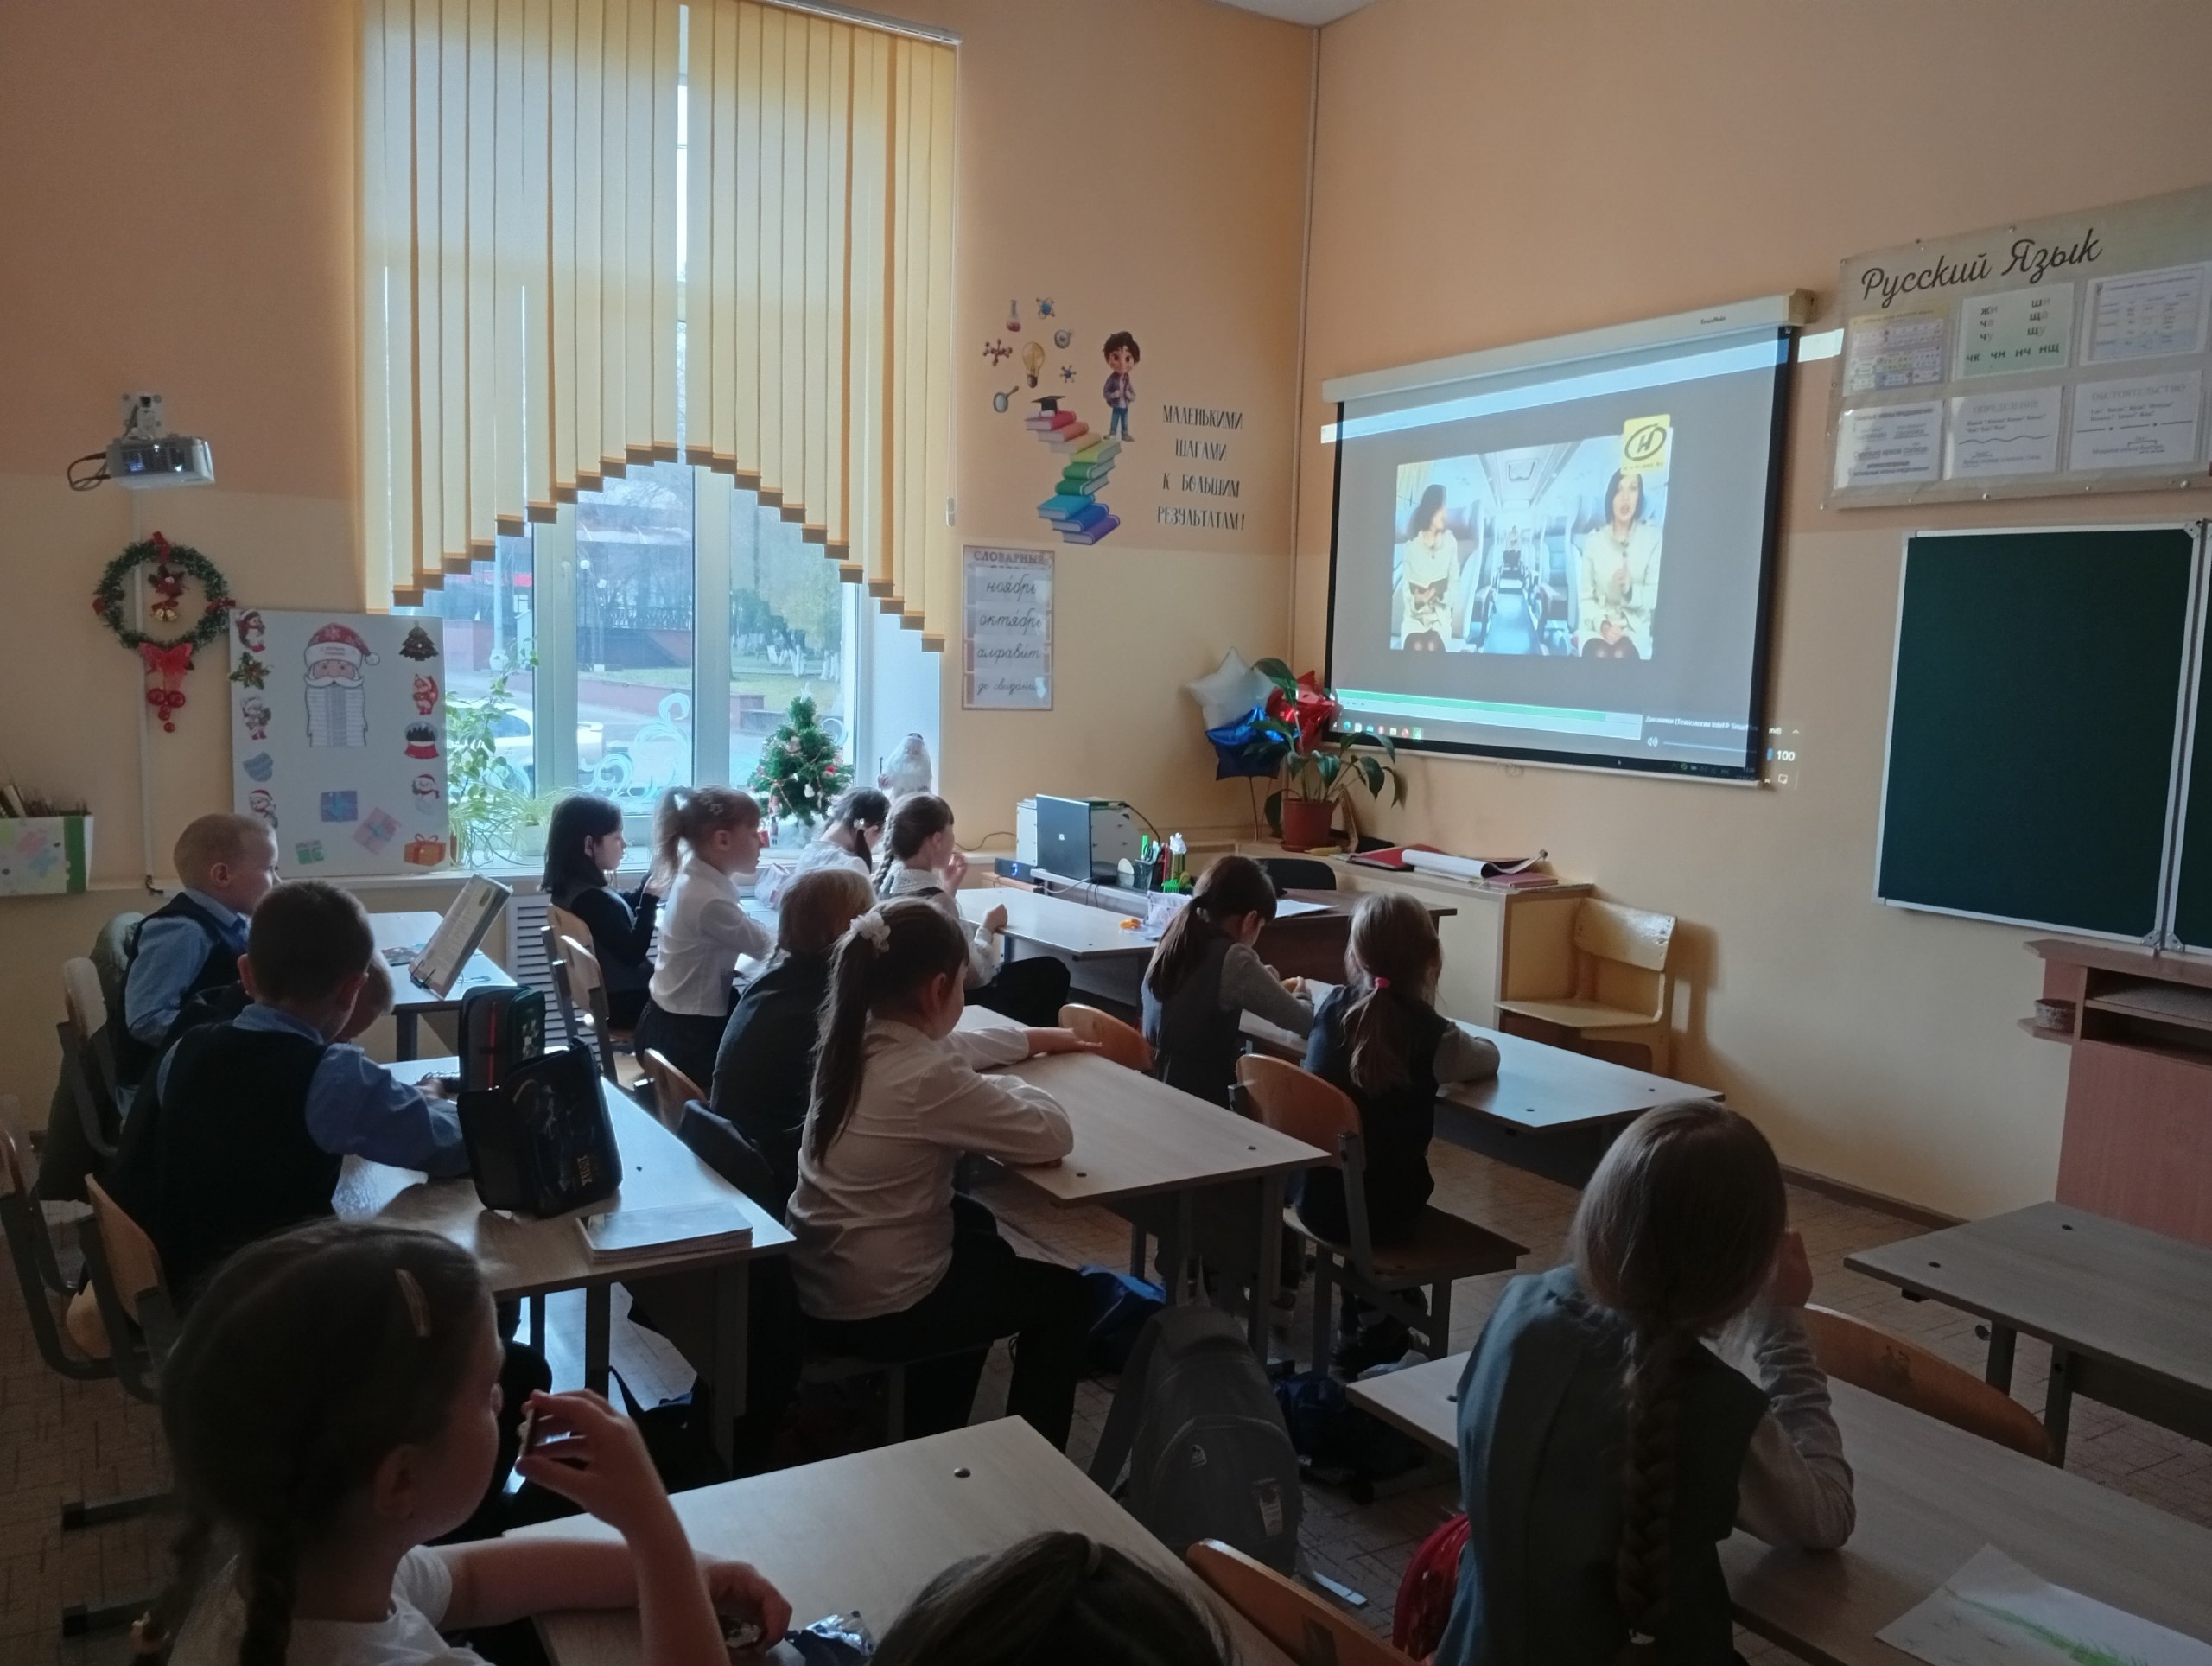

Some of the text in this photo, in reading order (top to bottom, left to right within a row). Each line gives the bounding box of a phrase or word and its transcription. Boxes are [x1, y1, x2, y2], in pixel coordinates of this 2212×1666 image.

[1861, 228, 2103, 308] Русский Язык
[1163, 405, 1243, 430] МАЛЕНЬКИМИ
[1176, 438, 1227, 461] ШАГАМИ
[1163, 473, 1240, 499] К БОЛЬШИМ
[1158, 506, 1245, 531] РЕЗУЛЬТАТАМ!
[1777, 750, 1796, 761] 100
